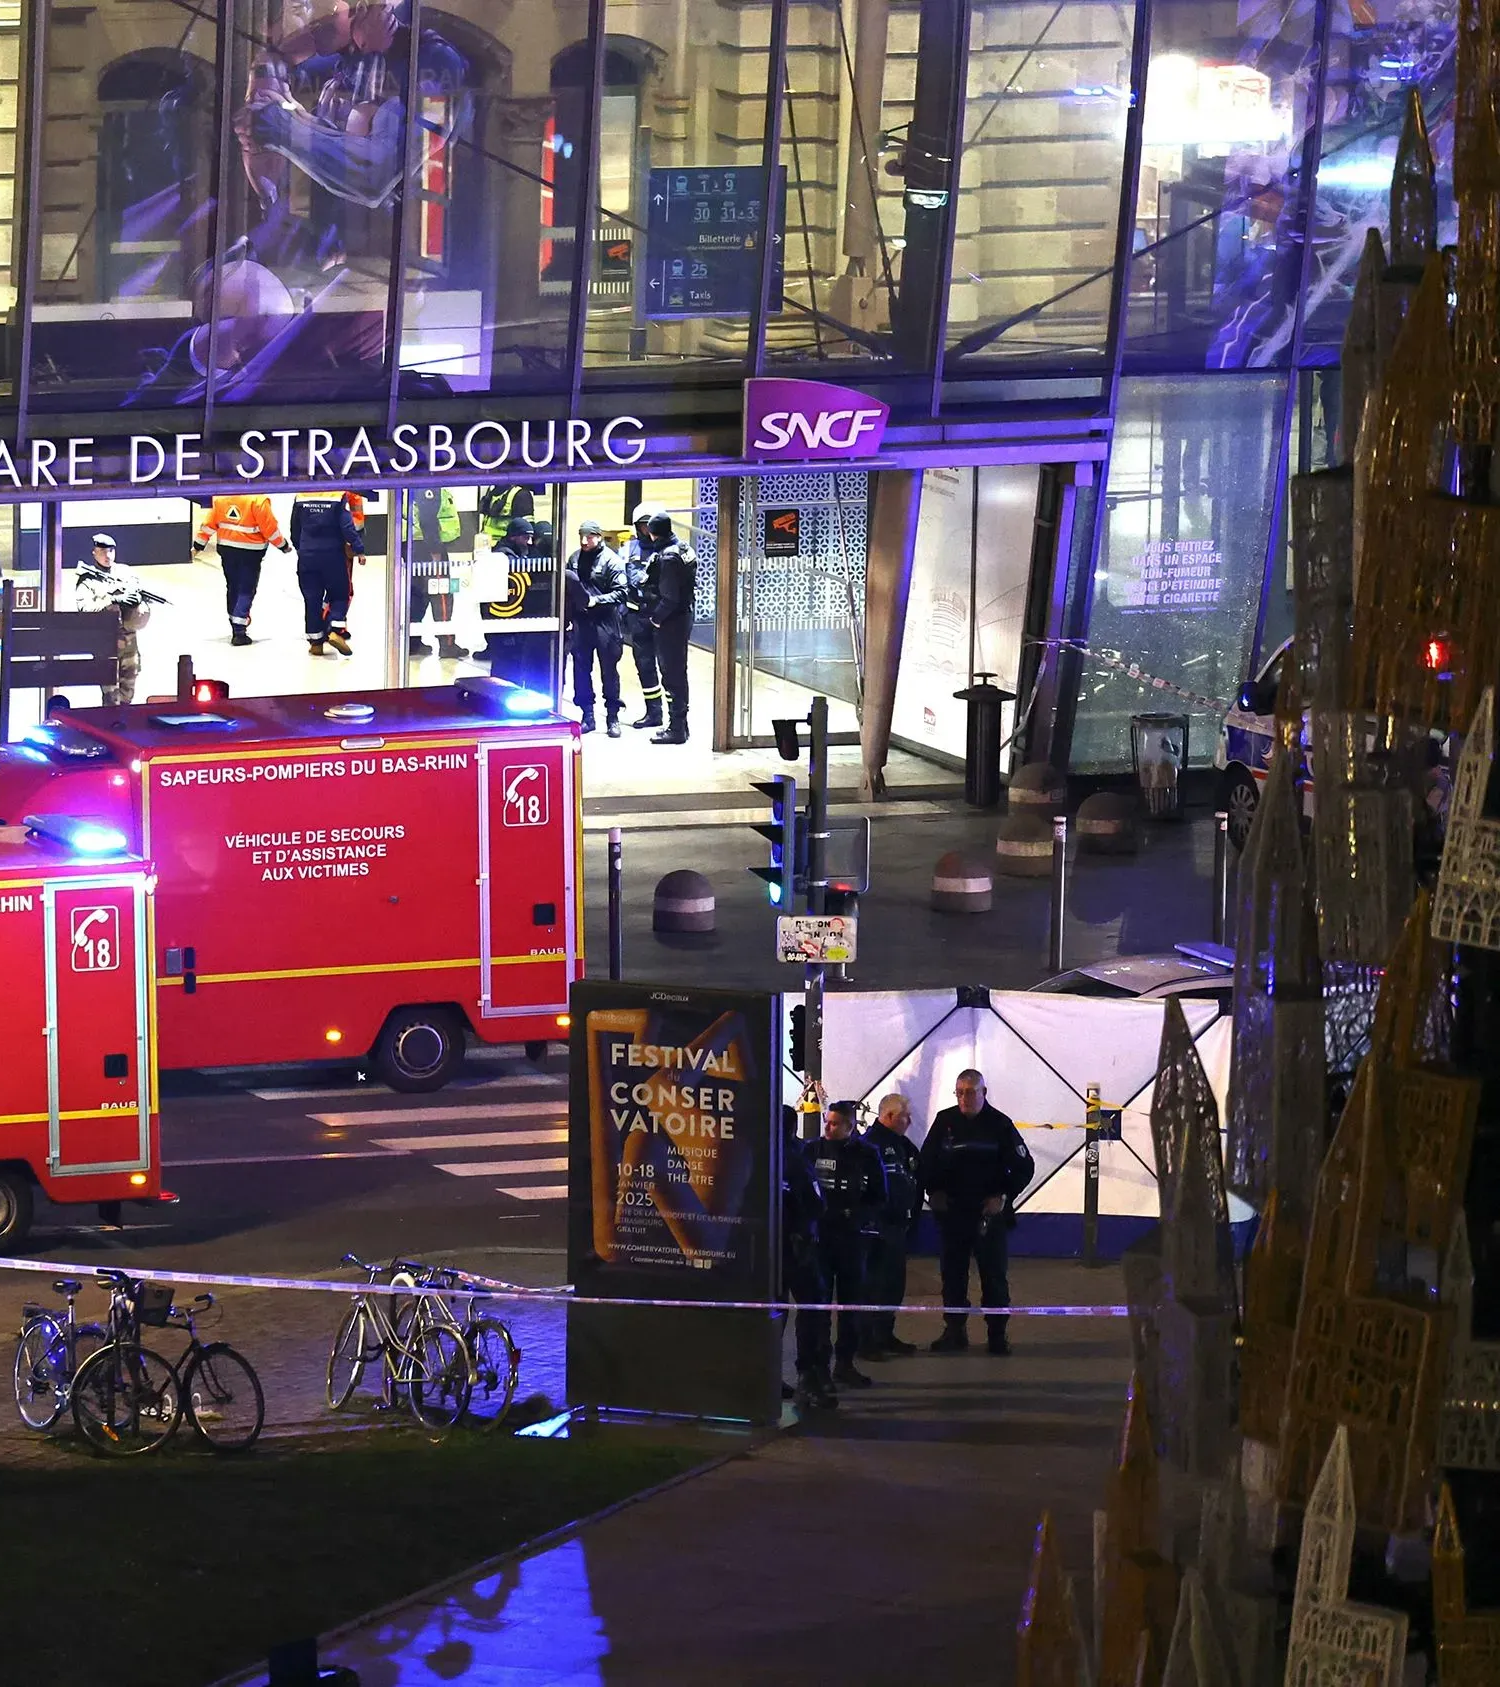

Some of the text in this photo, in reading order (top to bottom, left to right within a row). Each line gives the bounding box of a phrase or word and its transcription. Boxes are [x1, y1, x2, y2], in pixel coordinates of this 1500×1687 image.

[694, 207, 711, 220] 30
[699, 234, 741, 244] Billetterie
[689, 290, 711, 300] Taxis
[754, 408, 883, 450] SNCF
[130, 433, 201, 483] DE
[235, 416, 647, 480] STRASBOURG
[1144, 540, 1215, 553] VOUS ENTREZ
[1182, 553, 1222, 565] ESPACE
[1163, 591, 1220, 604] CIGARETTE
[159, 753, 468, 788] SAPEURS-POMPIERS DU BAS-RHIN
[514, 795, 541, 824] 18
[224, 824, 405, 849] VÉHICULE DE SECOURS
[252, 844, 387, 865] ET D'ASSISTANCE
[261, 862, 370, 882] AUX VICTIMES
[84, 938, 111, 968] 18
[529, 946, 564, 956] BAUS
[611, 1043, 736, 1073] FESTIVAL
[666, 1071, 681, 1082] du
[610, 1082, 735, 1112] CONSER
[100, 1100, 138, 1110] BAUS
[610, 1109, 735, 1140] VATOIRE
[667, 1146, 717, 1158] MUSIQUE
[616, 1163, 655, 1179] 10-18
[667, 1159, 704, 1171] DANSE
[617, 1180, 655, 1190] JANVIER
[616, 1192, 654, 1207] 2025
[617, 1224, 646, 1234] GRATUIT
